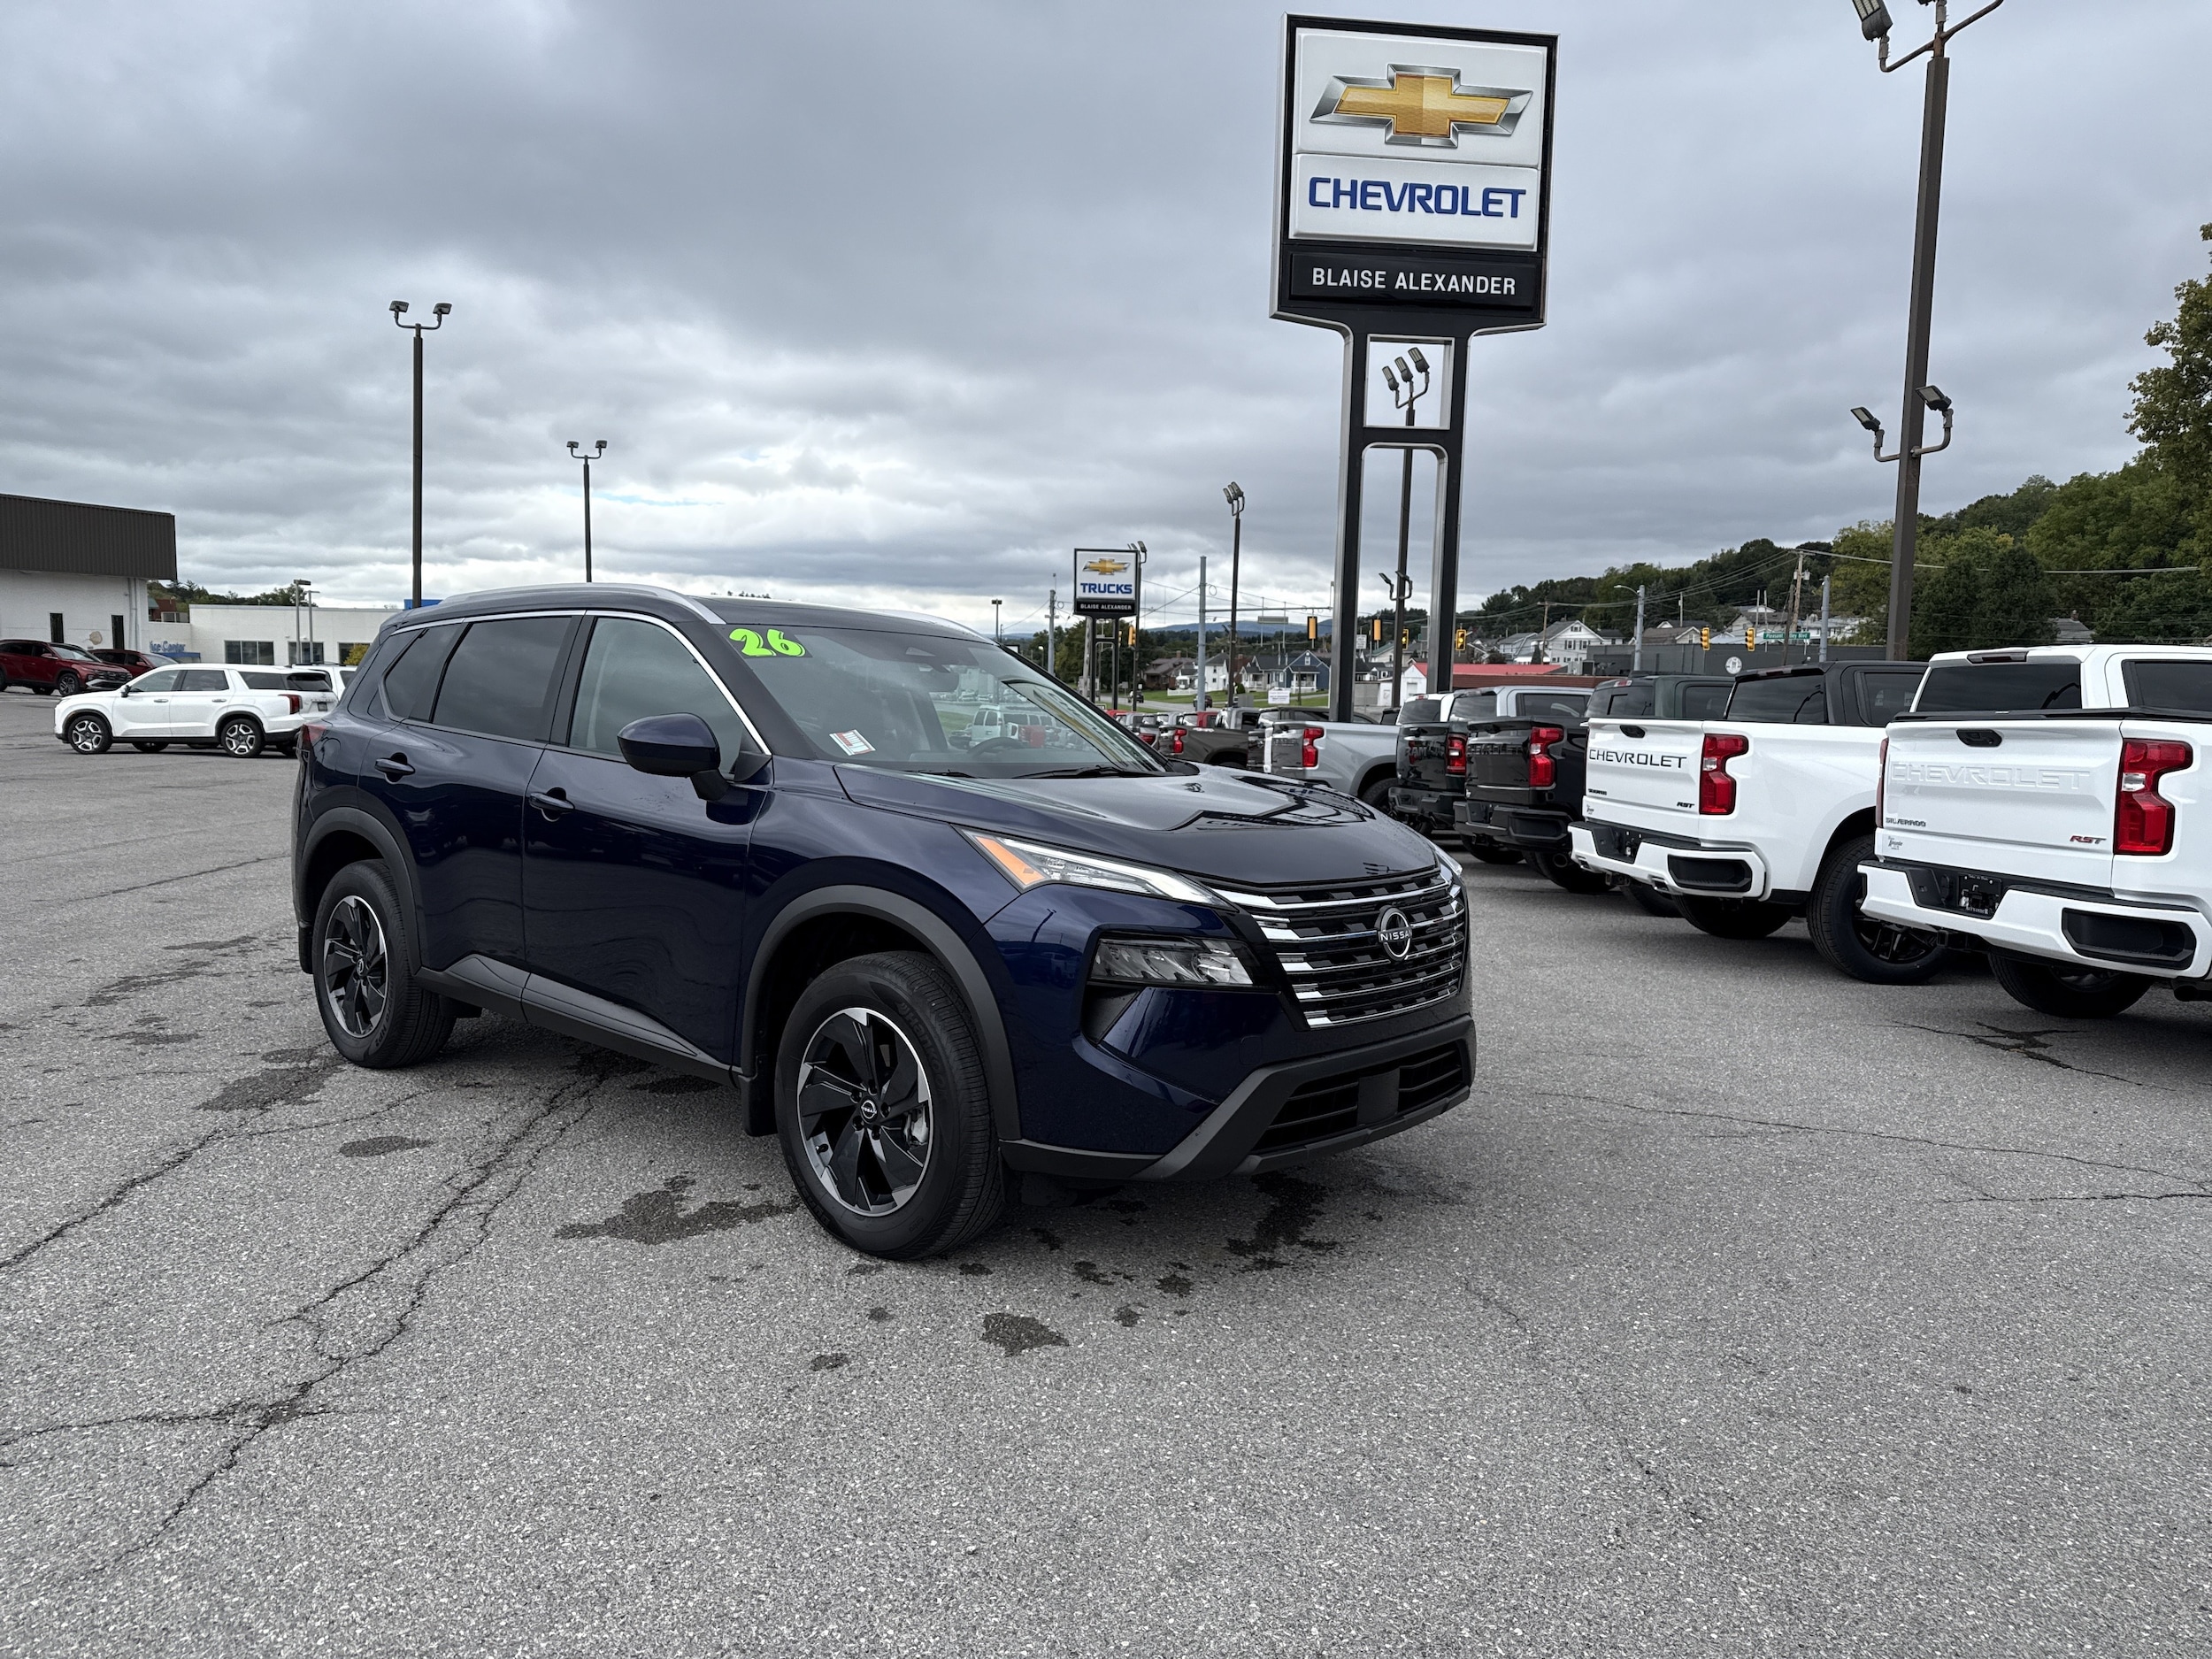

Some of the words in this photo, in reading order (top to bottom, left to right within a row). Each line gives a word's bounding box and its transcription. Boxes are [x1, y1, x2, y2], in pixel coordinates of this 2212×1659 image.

[1309, 176, 1526, 219] CHEVROLET
[1312, 267, 1386, 288] BLAISE
[1394, 272, 1516, 295] ALEXANDER
[1080, 582, 1133, 594] TRUCKS
[162, 641, 186, 652] Center
[729, 628, 806, 657] 26
[1589, 749, 1687, 769] CHEVROLET
[1891, 764, 2091, 790] CHEVROLET
[2070, 835, 2107, 844] RST
